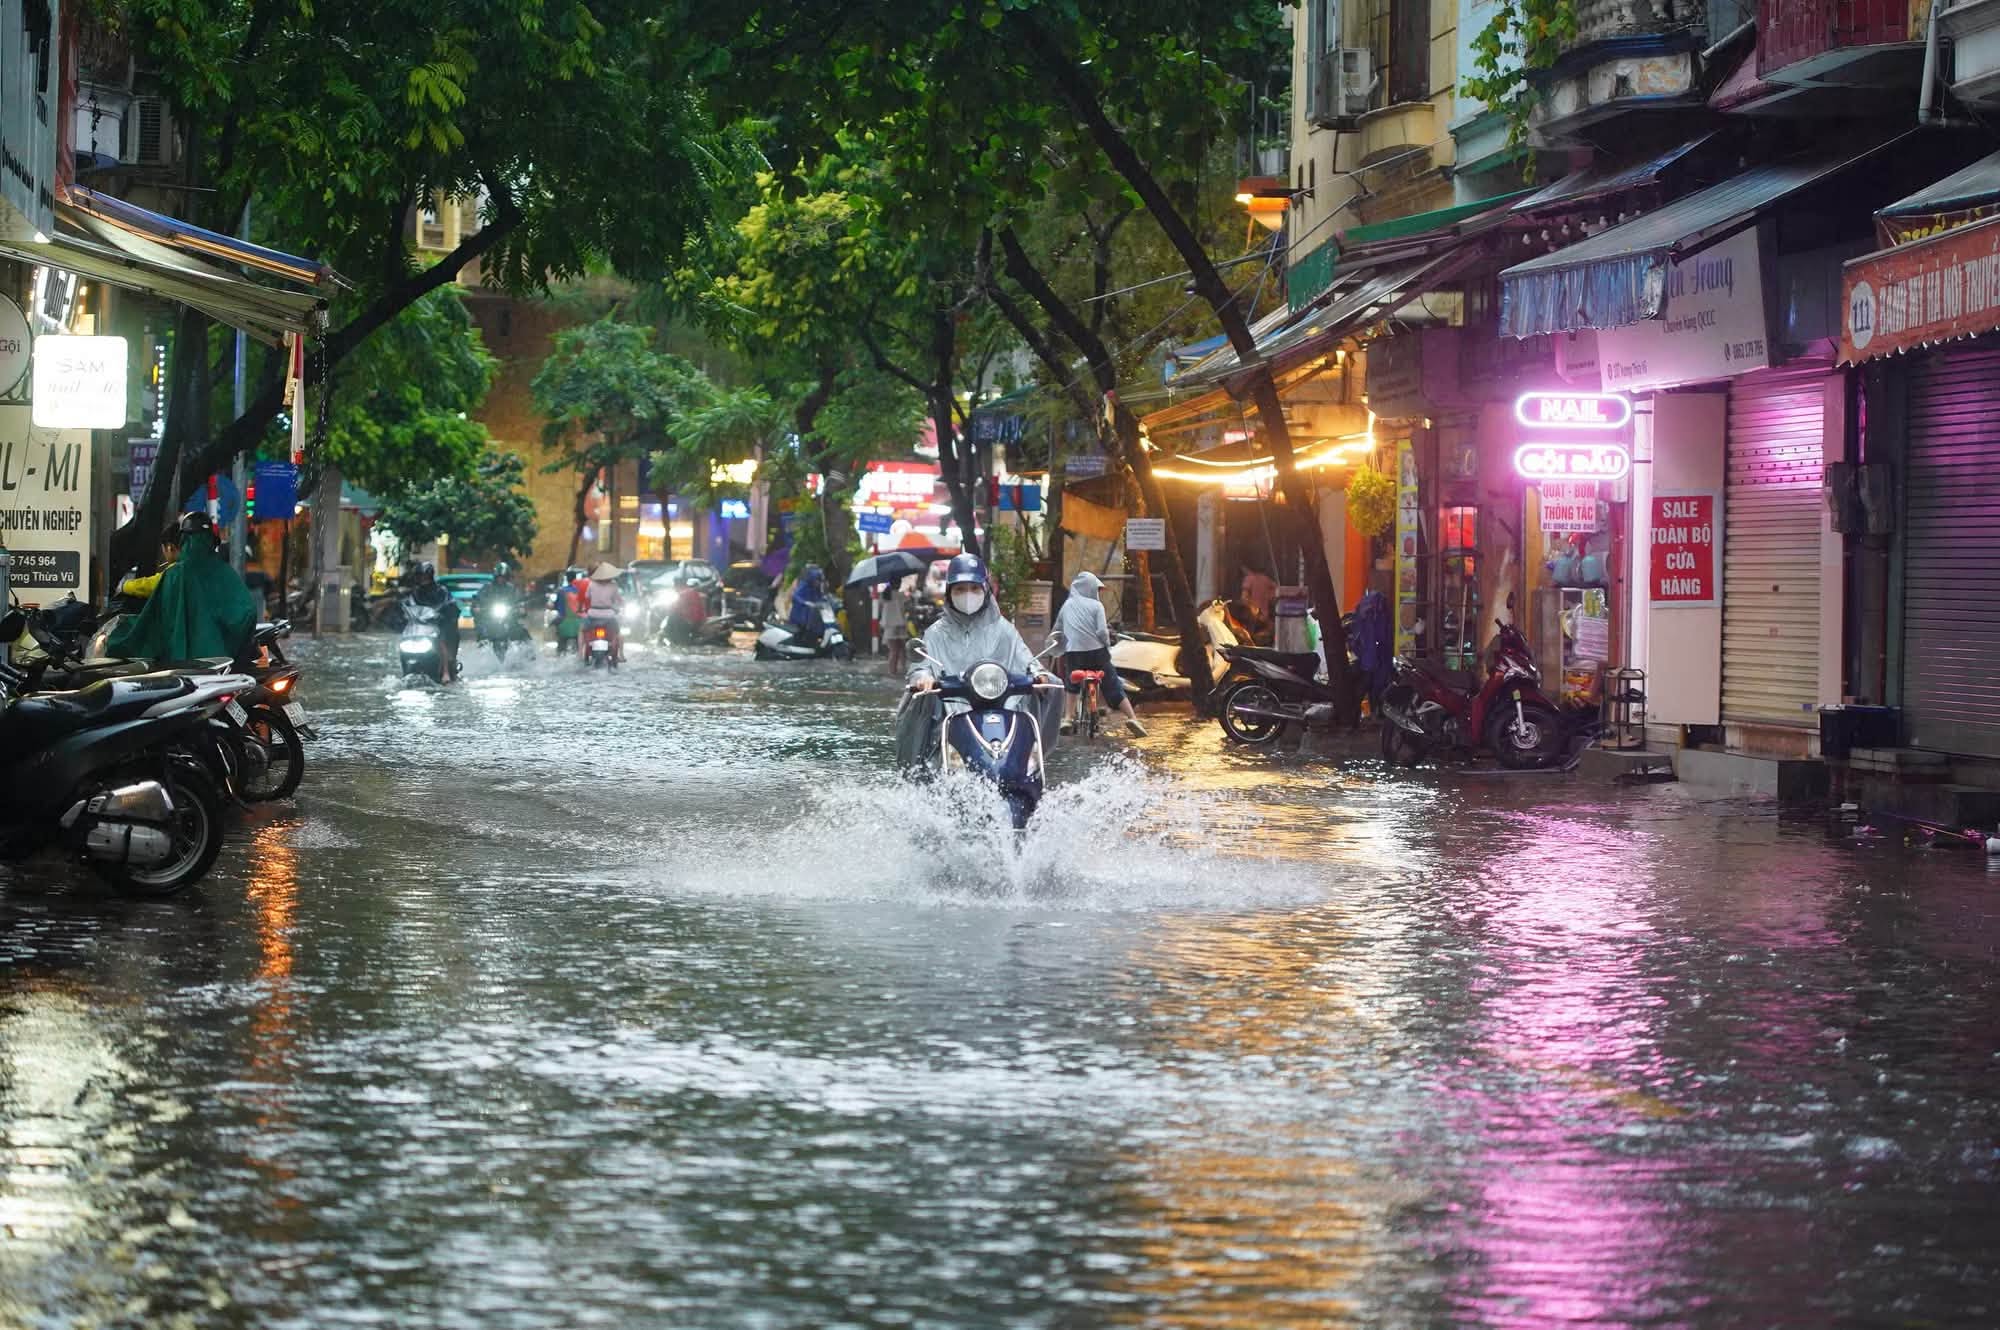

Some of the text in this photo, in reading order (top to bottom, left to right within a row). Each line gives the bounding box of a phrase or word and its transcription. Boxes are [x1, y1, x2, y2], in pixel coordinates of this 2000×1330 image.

[1852, 296, 1870, 333] 111
[1944, 253, 1961, 329] NỘI
[1540, 399, 1607, 421] NAIL
[0, 442, 16, 490] L
[44, 442, 82, 491] MI
[43, 505, 82, 535] NGHIỆP
[1663, 501, 1698, 518] SALE
[1651, 523, 1711, 547] TOÀN BỘ
[19, 556, 36, 566] 745
[38, 556, 56, 566] 964
[1666, 546, 1696, 569] CỬA
[32, 570, 58, 582] Thừa
[61, 571, 74, 582] Vũ
[1661, 575, 1701, 595] HÀNG
